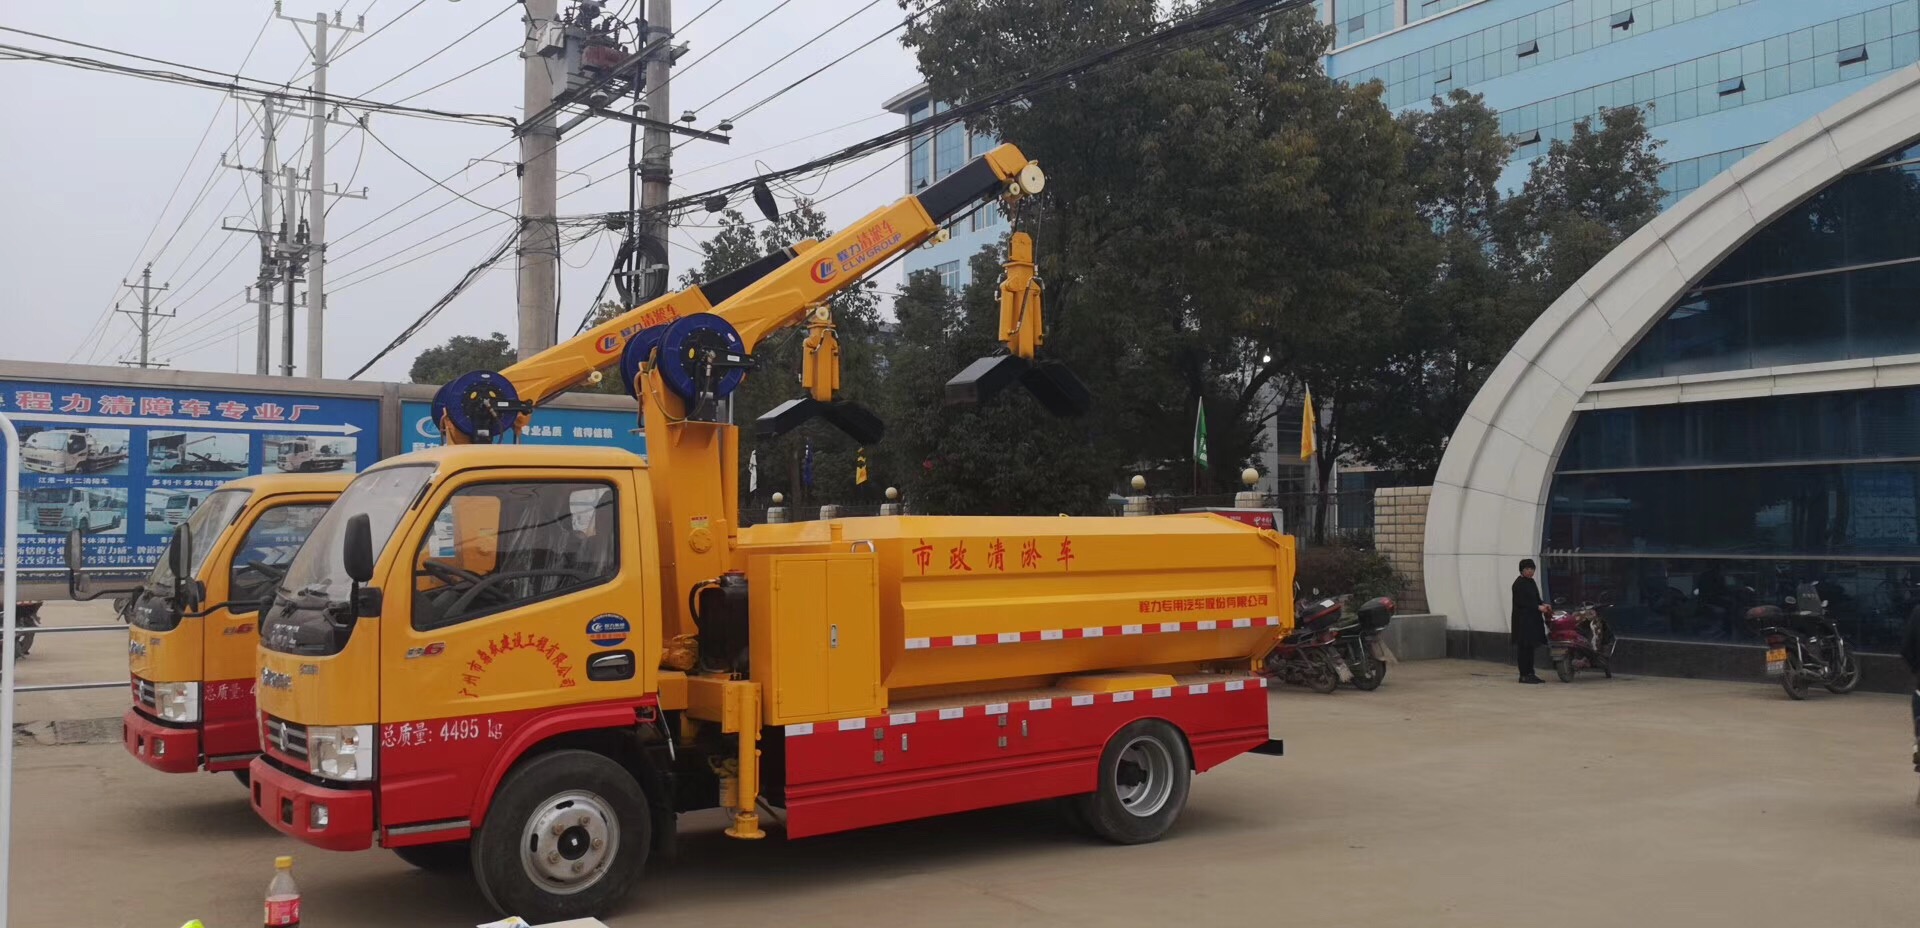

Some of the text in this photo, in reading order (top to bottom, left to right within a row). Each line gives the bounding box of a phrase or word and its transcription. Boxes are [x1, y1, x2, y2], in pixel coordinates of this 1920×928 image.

[842, 232, 902, 273] CLW GROUP
[15, 390, 320, 421] 程力清障车专业厂
[151, 478, 231, 487] 多利卡多功能清
[911, 535, 1075, 576] 市政清淤车
[1139, 594, 1268, 613] 程力专用汽车股份有限公司
[439, 718, 480, 742] 4495
[487, 718, 504, 740] kg
